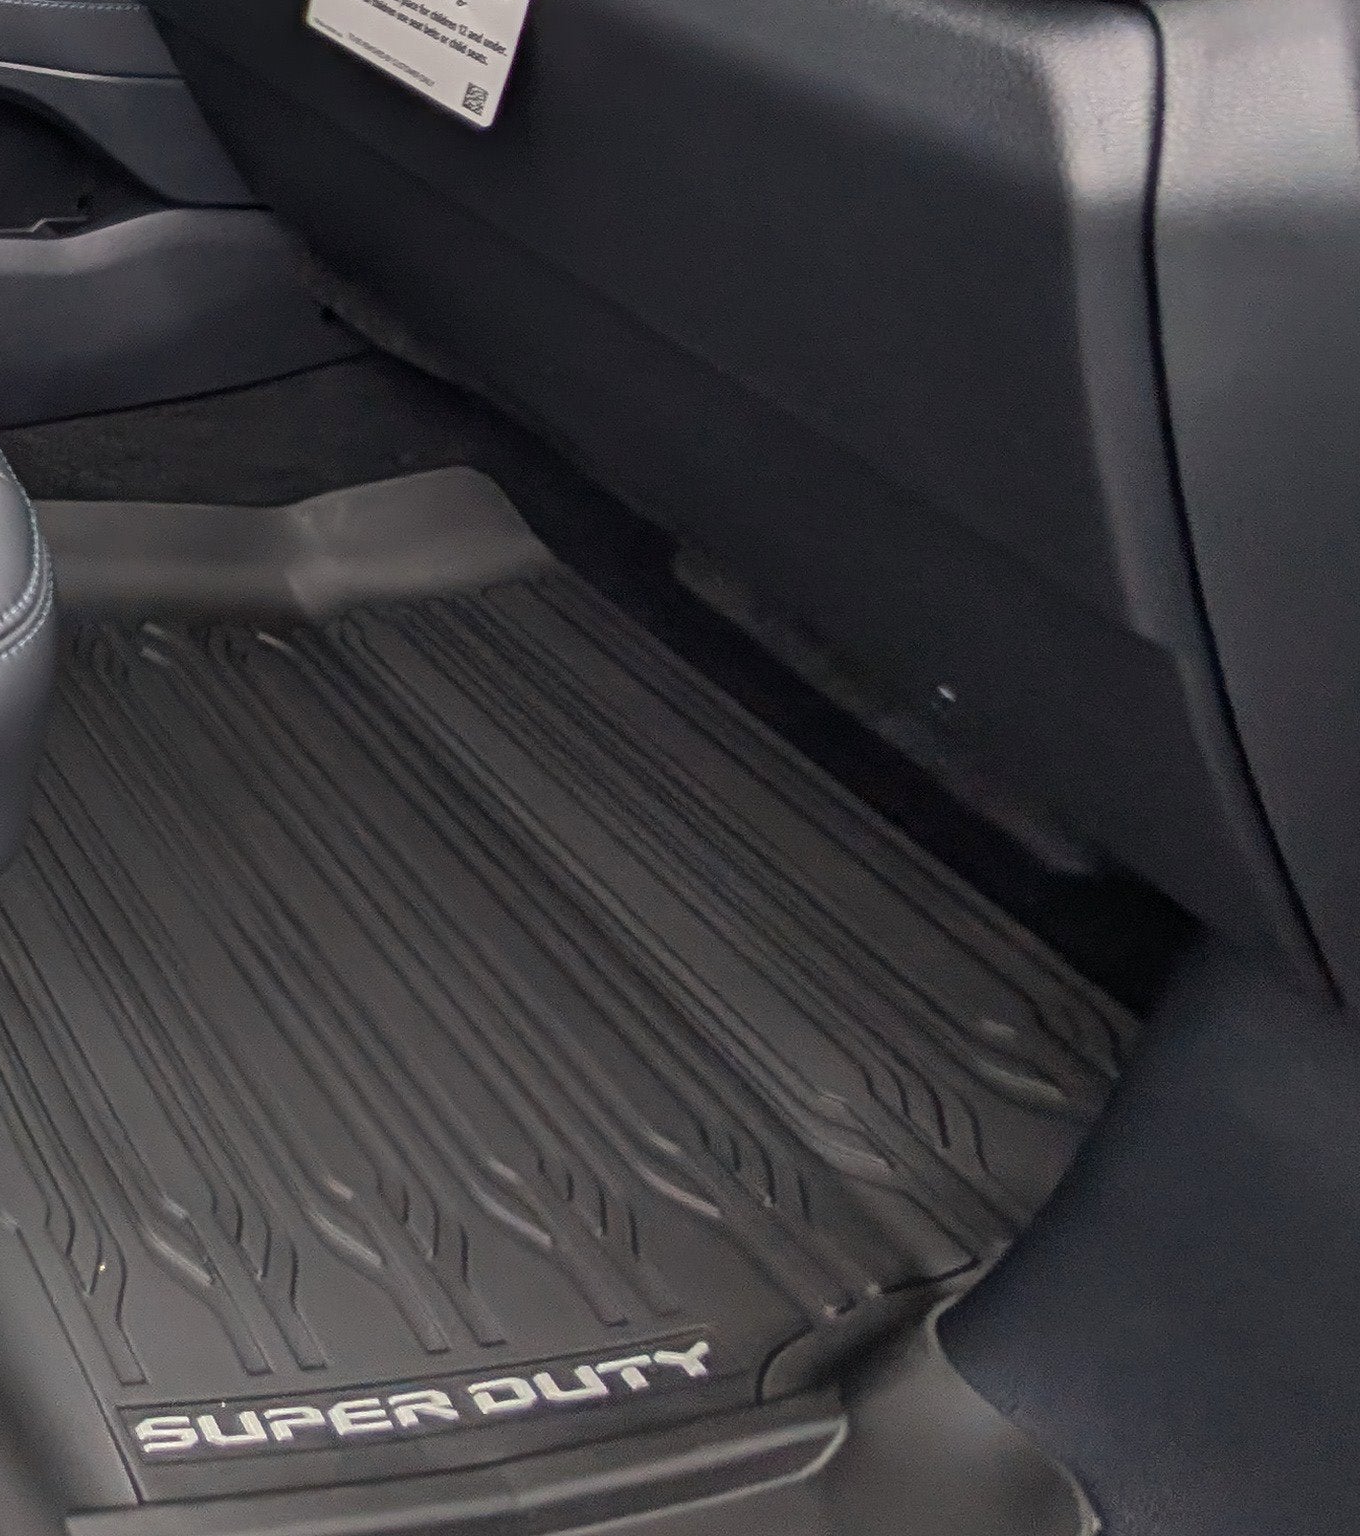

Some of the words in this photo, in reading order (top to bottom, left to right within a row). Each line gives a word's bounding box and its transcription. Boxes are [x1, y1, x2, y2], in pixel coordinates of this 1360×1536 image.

[459, 24, 468, 37] 12
[468, 30, 484, 44] and
[134, 1387, 459, 1454] SUPER
[466, 1339, 711, 1416] DUTY
